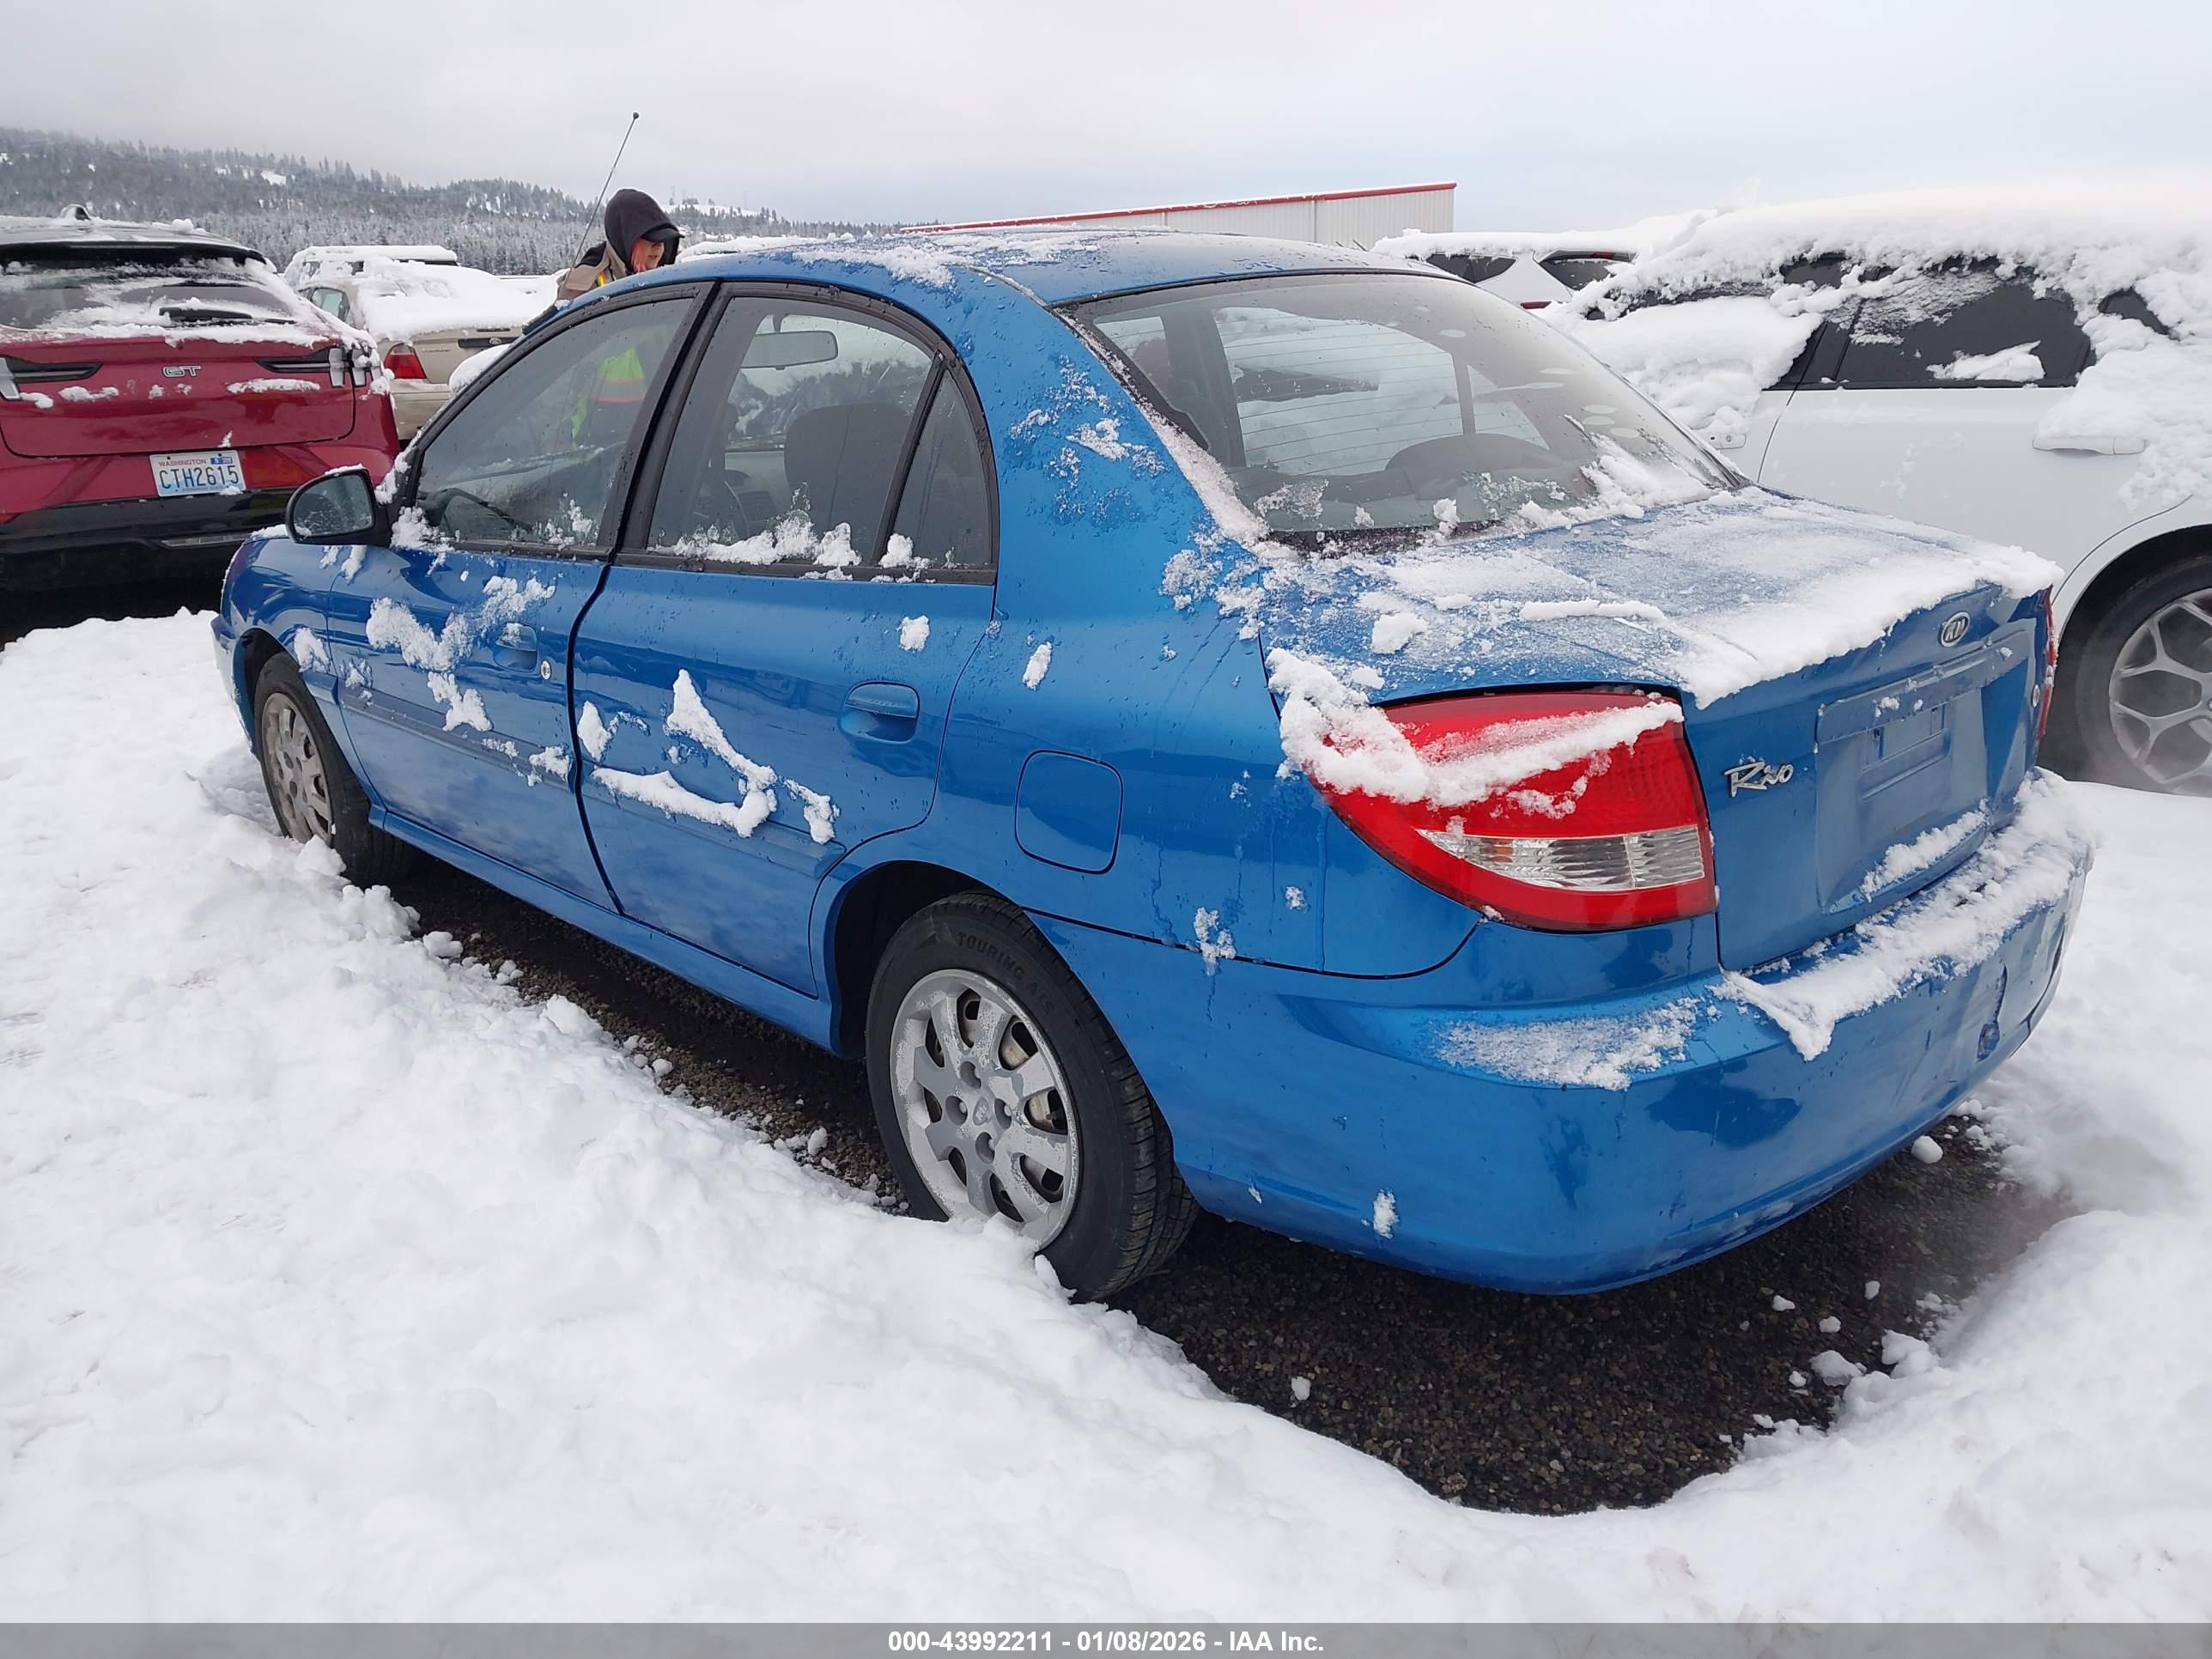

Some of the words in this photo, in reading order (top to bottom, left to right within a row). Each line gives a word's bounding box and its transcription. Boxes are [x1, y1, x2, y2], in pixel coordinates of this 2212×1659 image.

[162, 365, 202, 378] GT
[158, 459, 207, 467] WASHINGTON
[159, 465, 239, 489] CTH2615
[1724, 762, 1794, 798] Rio
[957, 932, 1024, 981] TOURING
